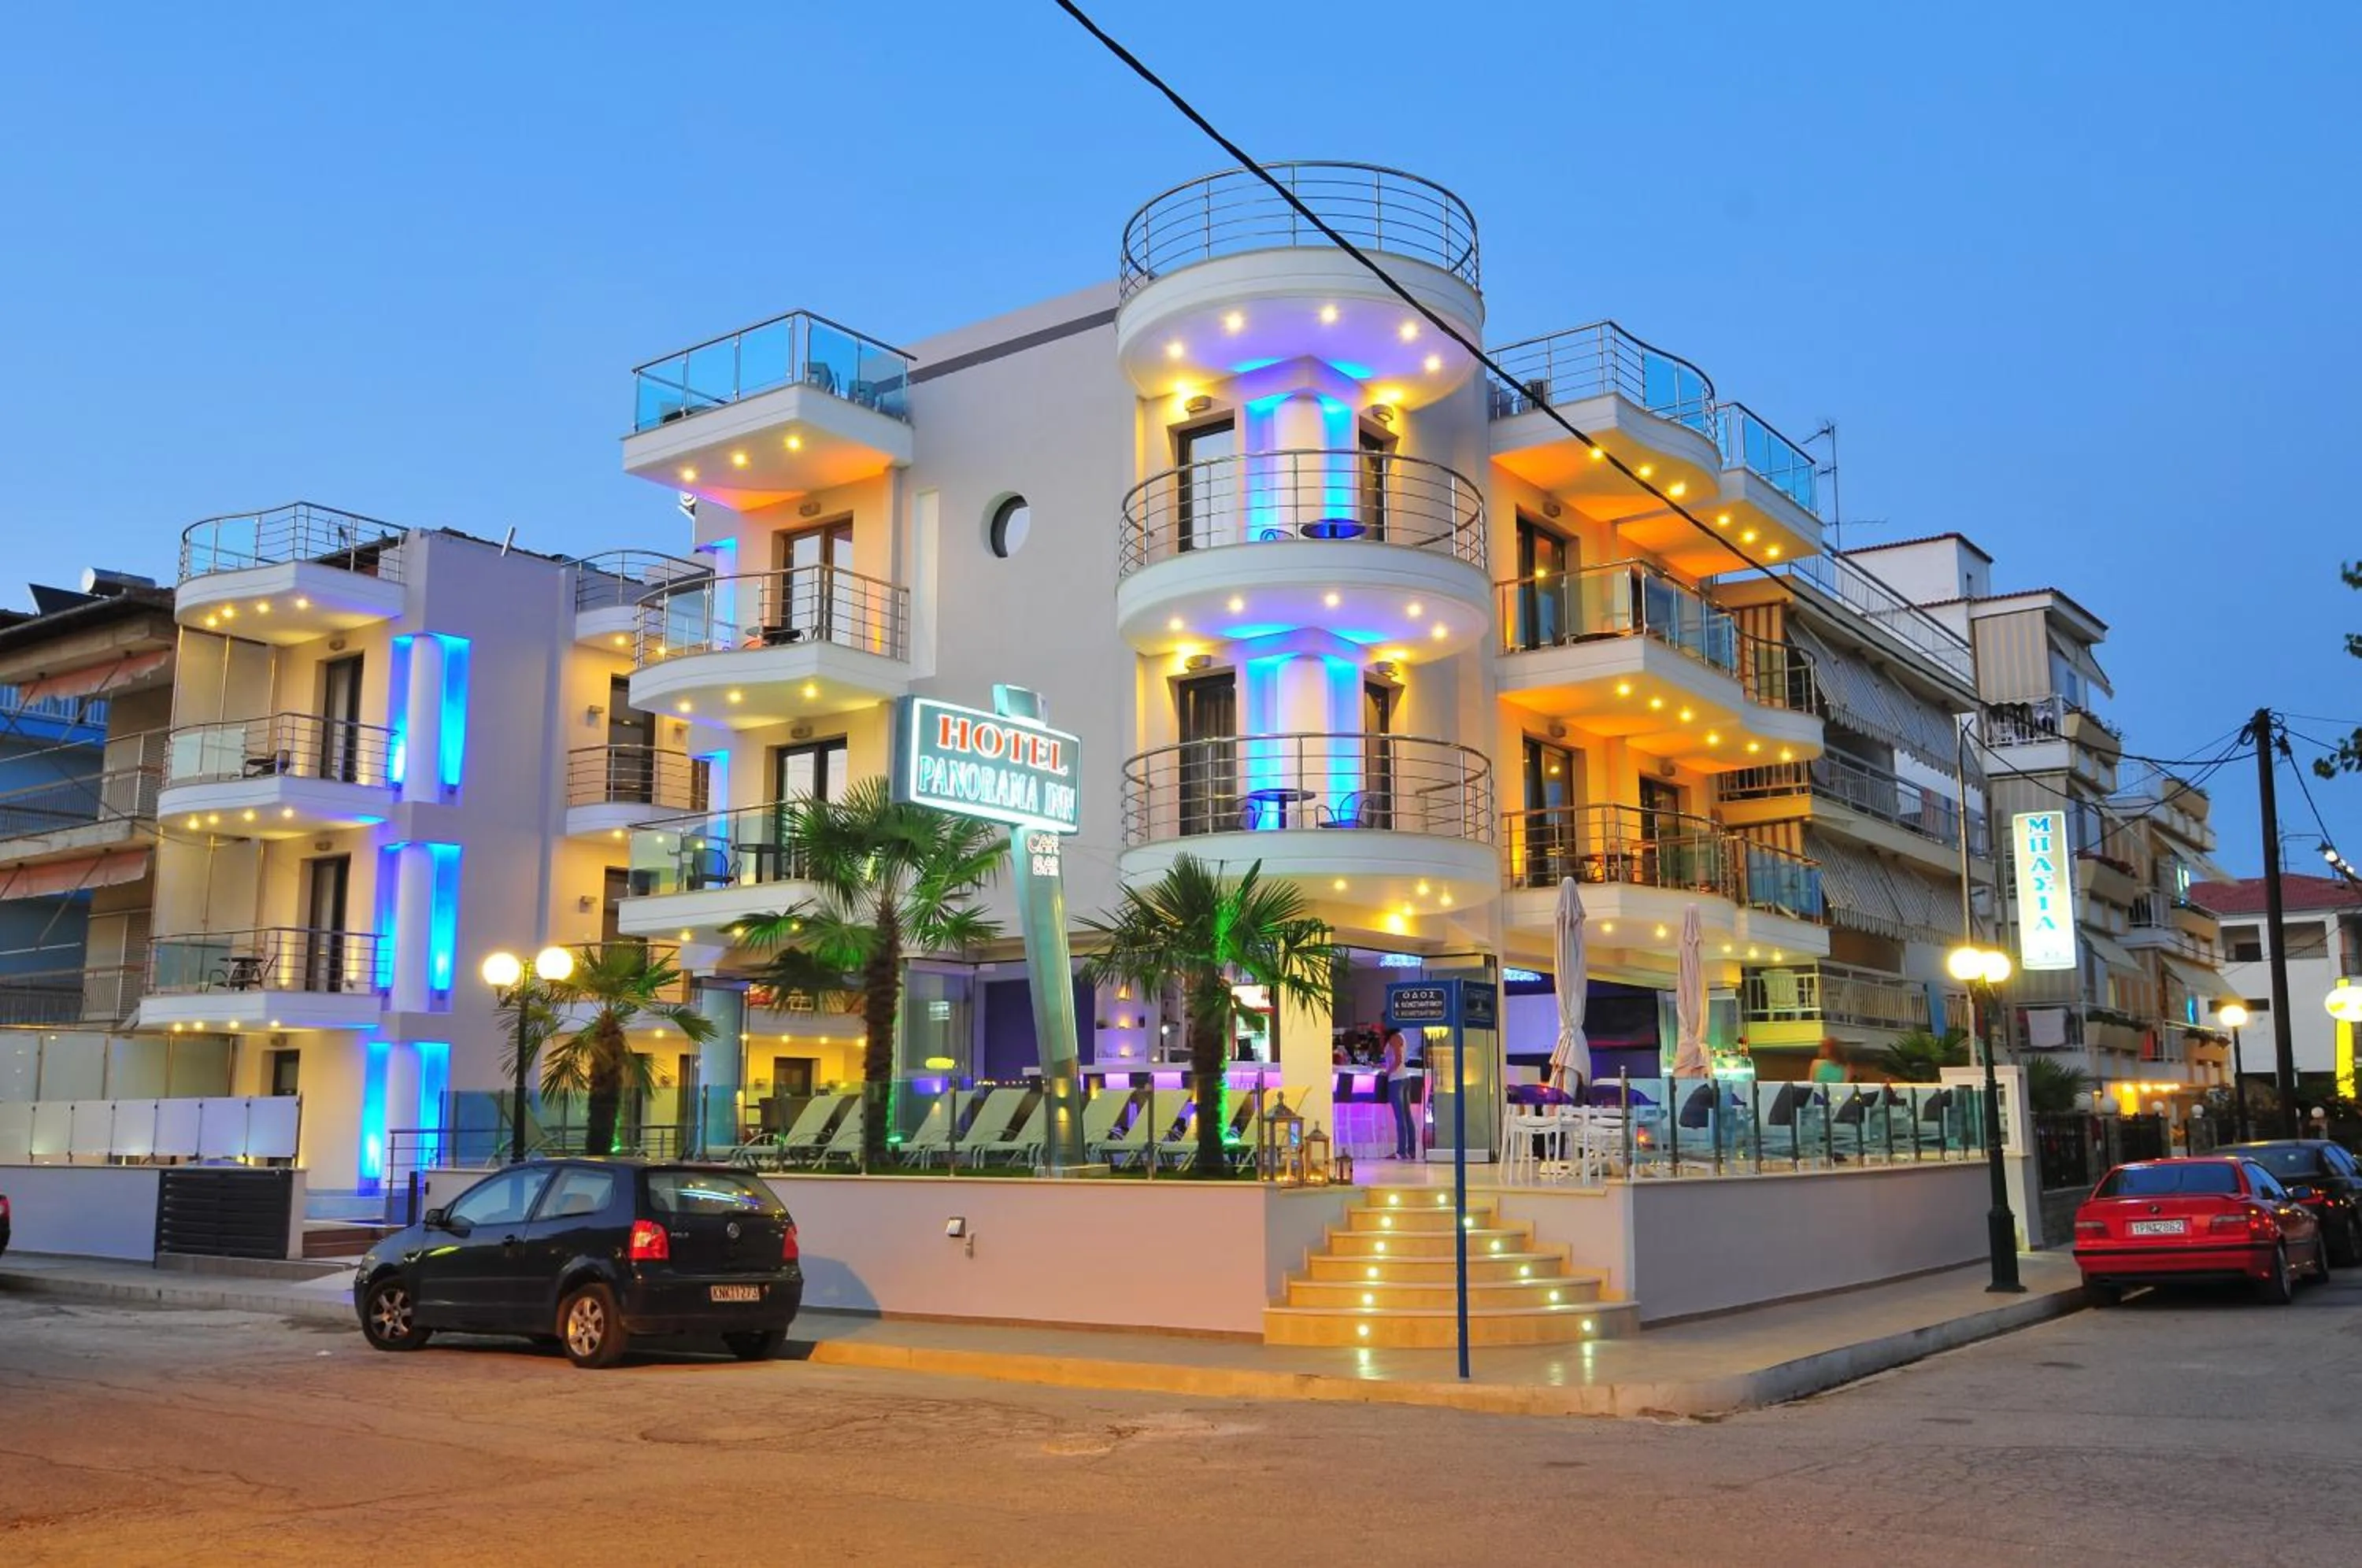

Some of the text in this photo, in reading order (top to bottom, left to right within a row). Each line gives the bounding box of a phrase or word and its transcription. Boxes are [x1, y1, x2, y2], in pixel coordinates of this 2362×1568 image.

[937, 714, 1068, 776] HOTEL
[918, 755, 1075, 822] PANORAMA INN
